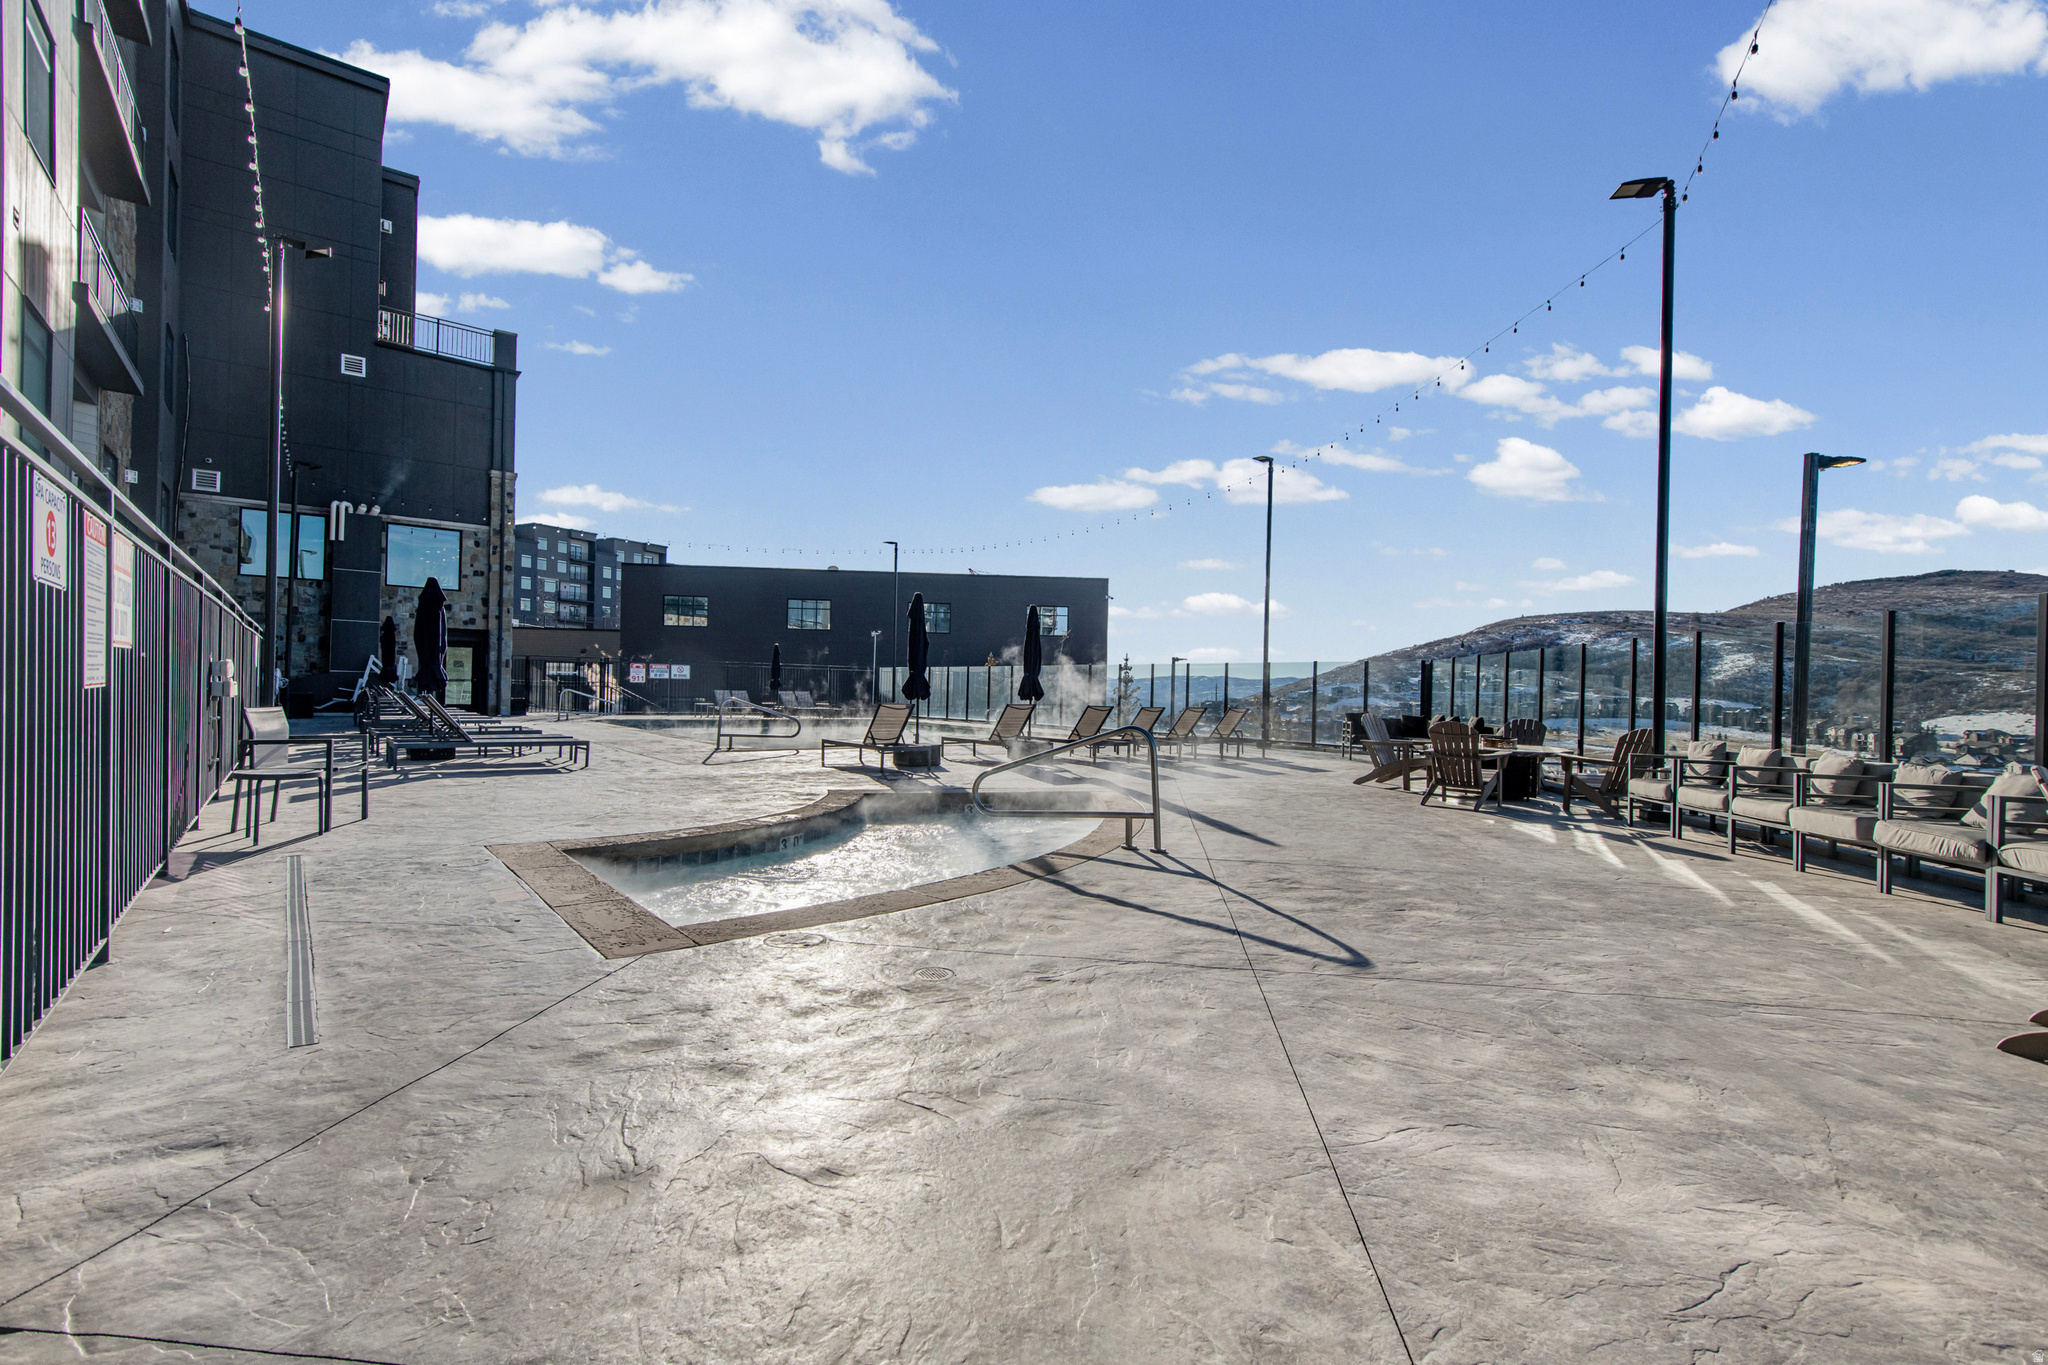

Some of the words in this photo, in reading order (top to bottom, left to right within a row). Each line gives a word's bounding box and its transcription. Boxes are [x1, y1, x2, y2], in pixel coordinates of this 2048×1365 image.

[35, 480, 44, 501] SPA
[45, 488, 65, 516] CAPACITY
[47, 519, 56, 549] 13
[87, 516, 106, 544] CAUTION
[40, 556, 61, 580] PERSONS
